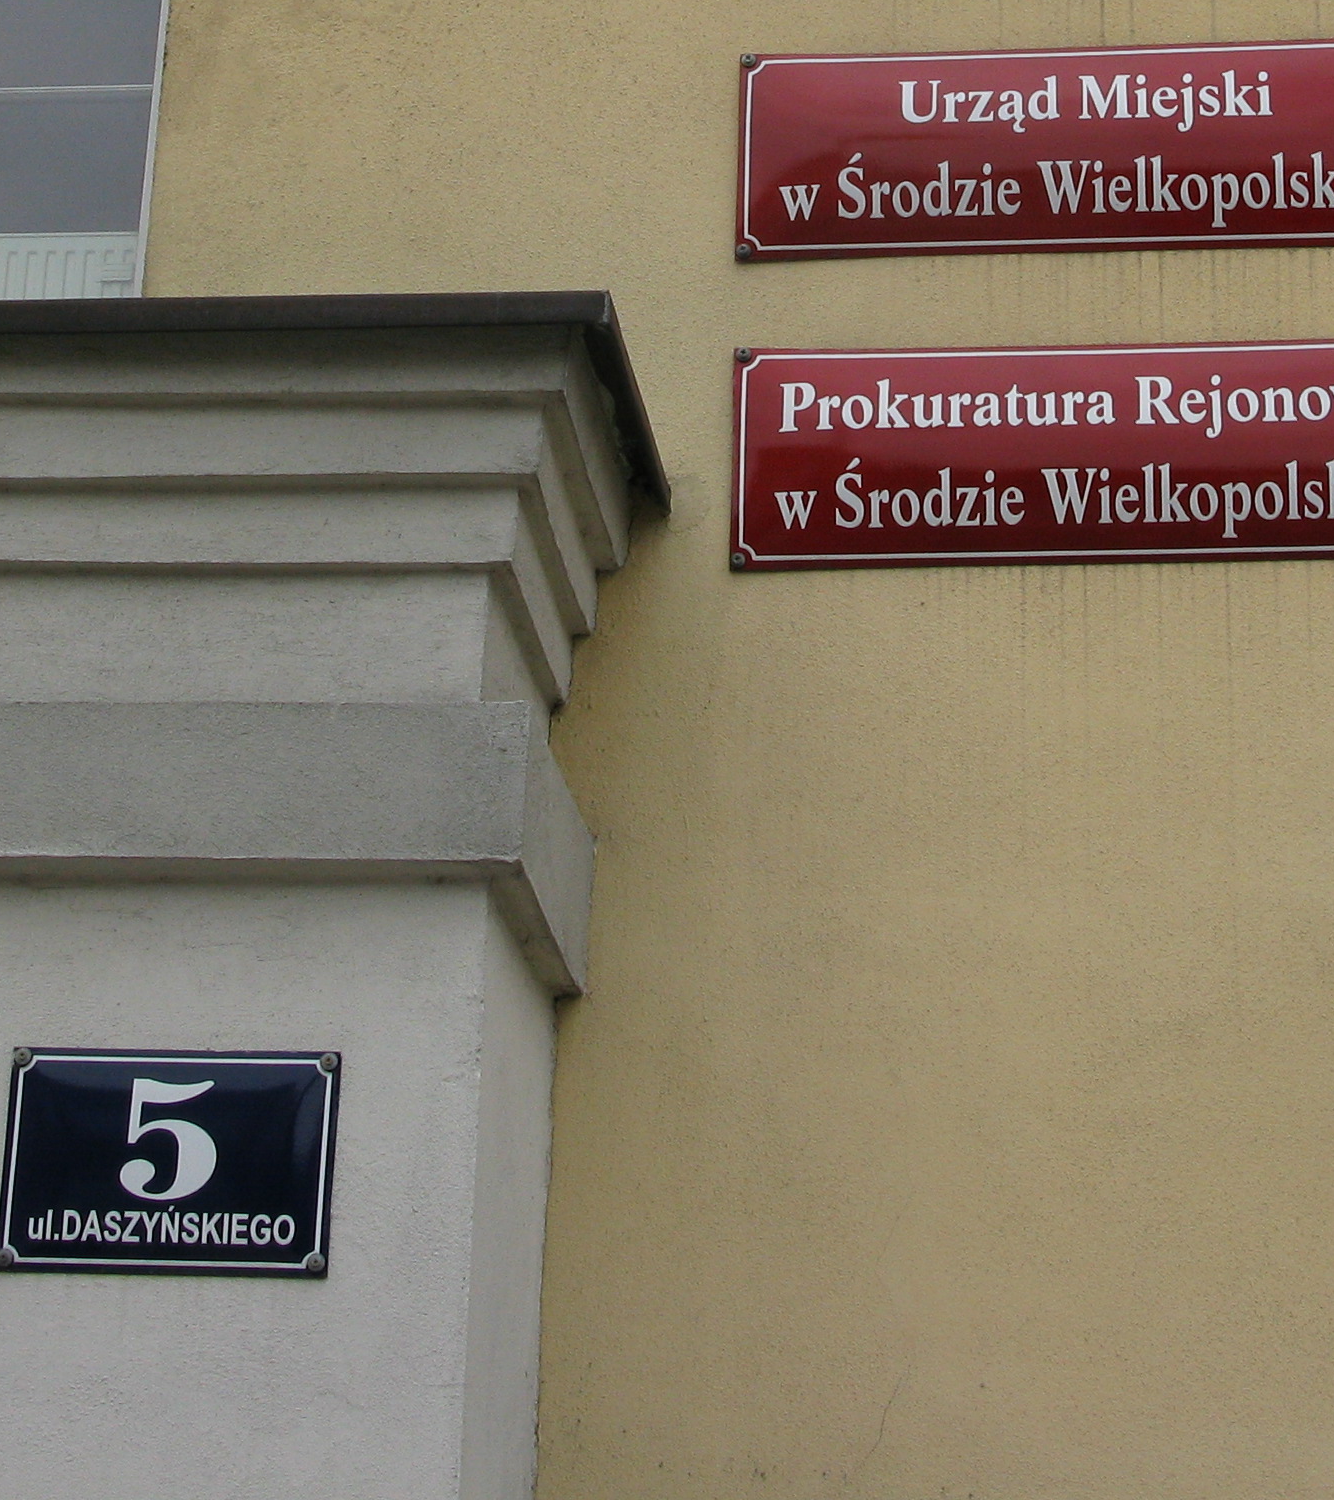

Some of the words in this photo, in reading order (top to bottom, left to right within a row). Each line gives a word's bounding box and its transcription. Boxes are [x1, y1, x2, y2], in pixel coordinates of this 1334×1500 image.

[898, 75, 1060, 132] Urząd
[1078, 70, 1273, 132] Miejski
[780, 184, 820, 220] w
[837, 153, 1021, 219] Środzie
[779, 379, 1115, 433] Prokuratura
[774, 490, 817, 530] w
[834, 459, 1024, 529] Środzie
[120, 1078, 216, 1200] 5
